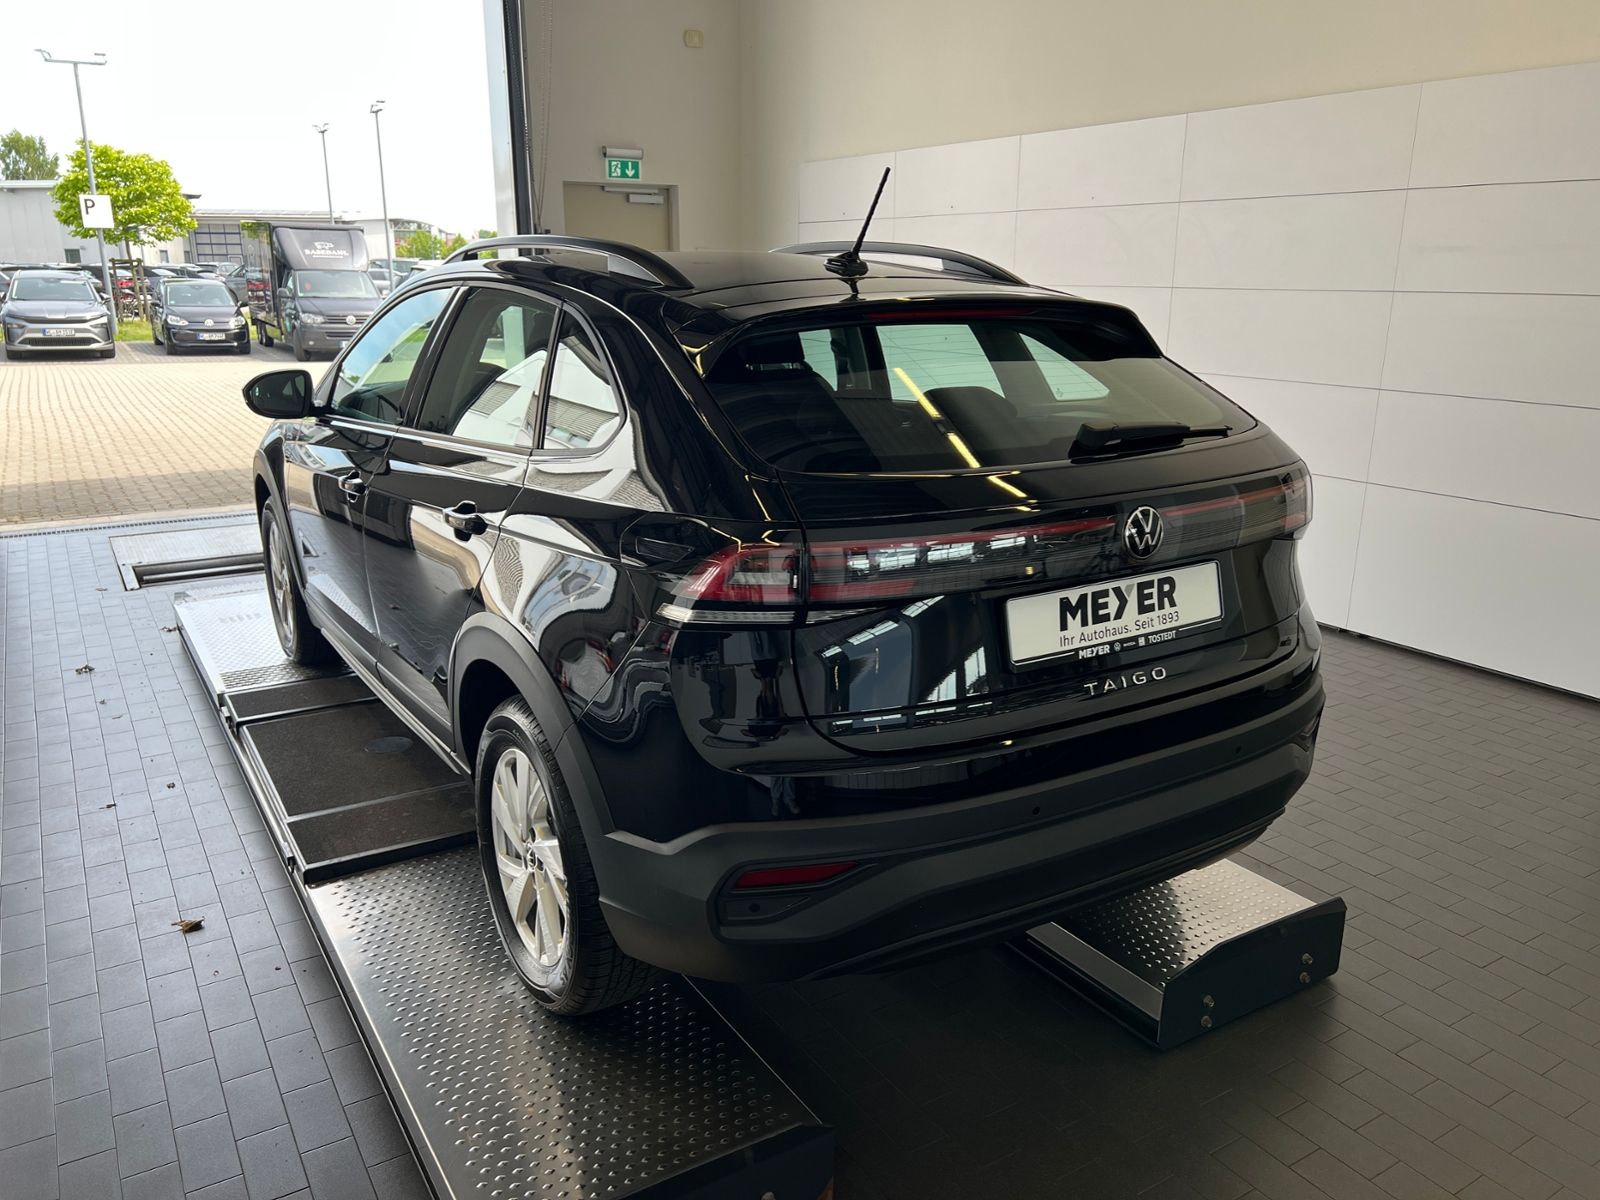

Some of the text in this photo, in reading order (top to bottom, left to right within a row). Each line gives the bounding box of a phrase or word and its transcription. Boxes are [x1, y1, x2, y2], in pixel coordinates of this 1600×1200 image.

[84, 198, 95, 215] P
[1059, 576, 1177, 632] MEYER
[1059, 610, 1180, 648] Ihr Autohaus. Seit 1893
[1078, 630, 1177, 660] MEYER TOSTEDT
[1083, 666, 1167, 696] TAIGO
